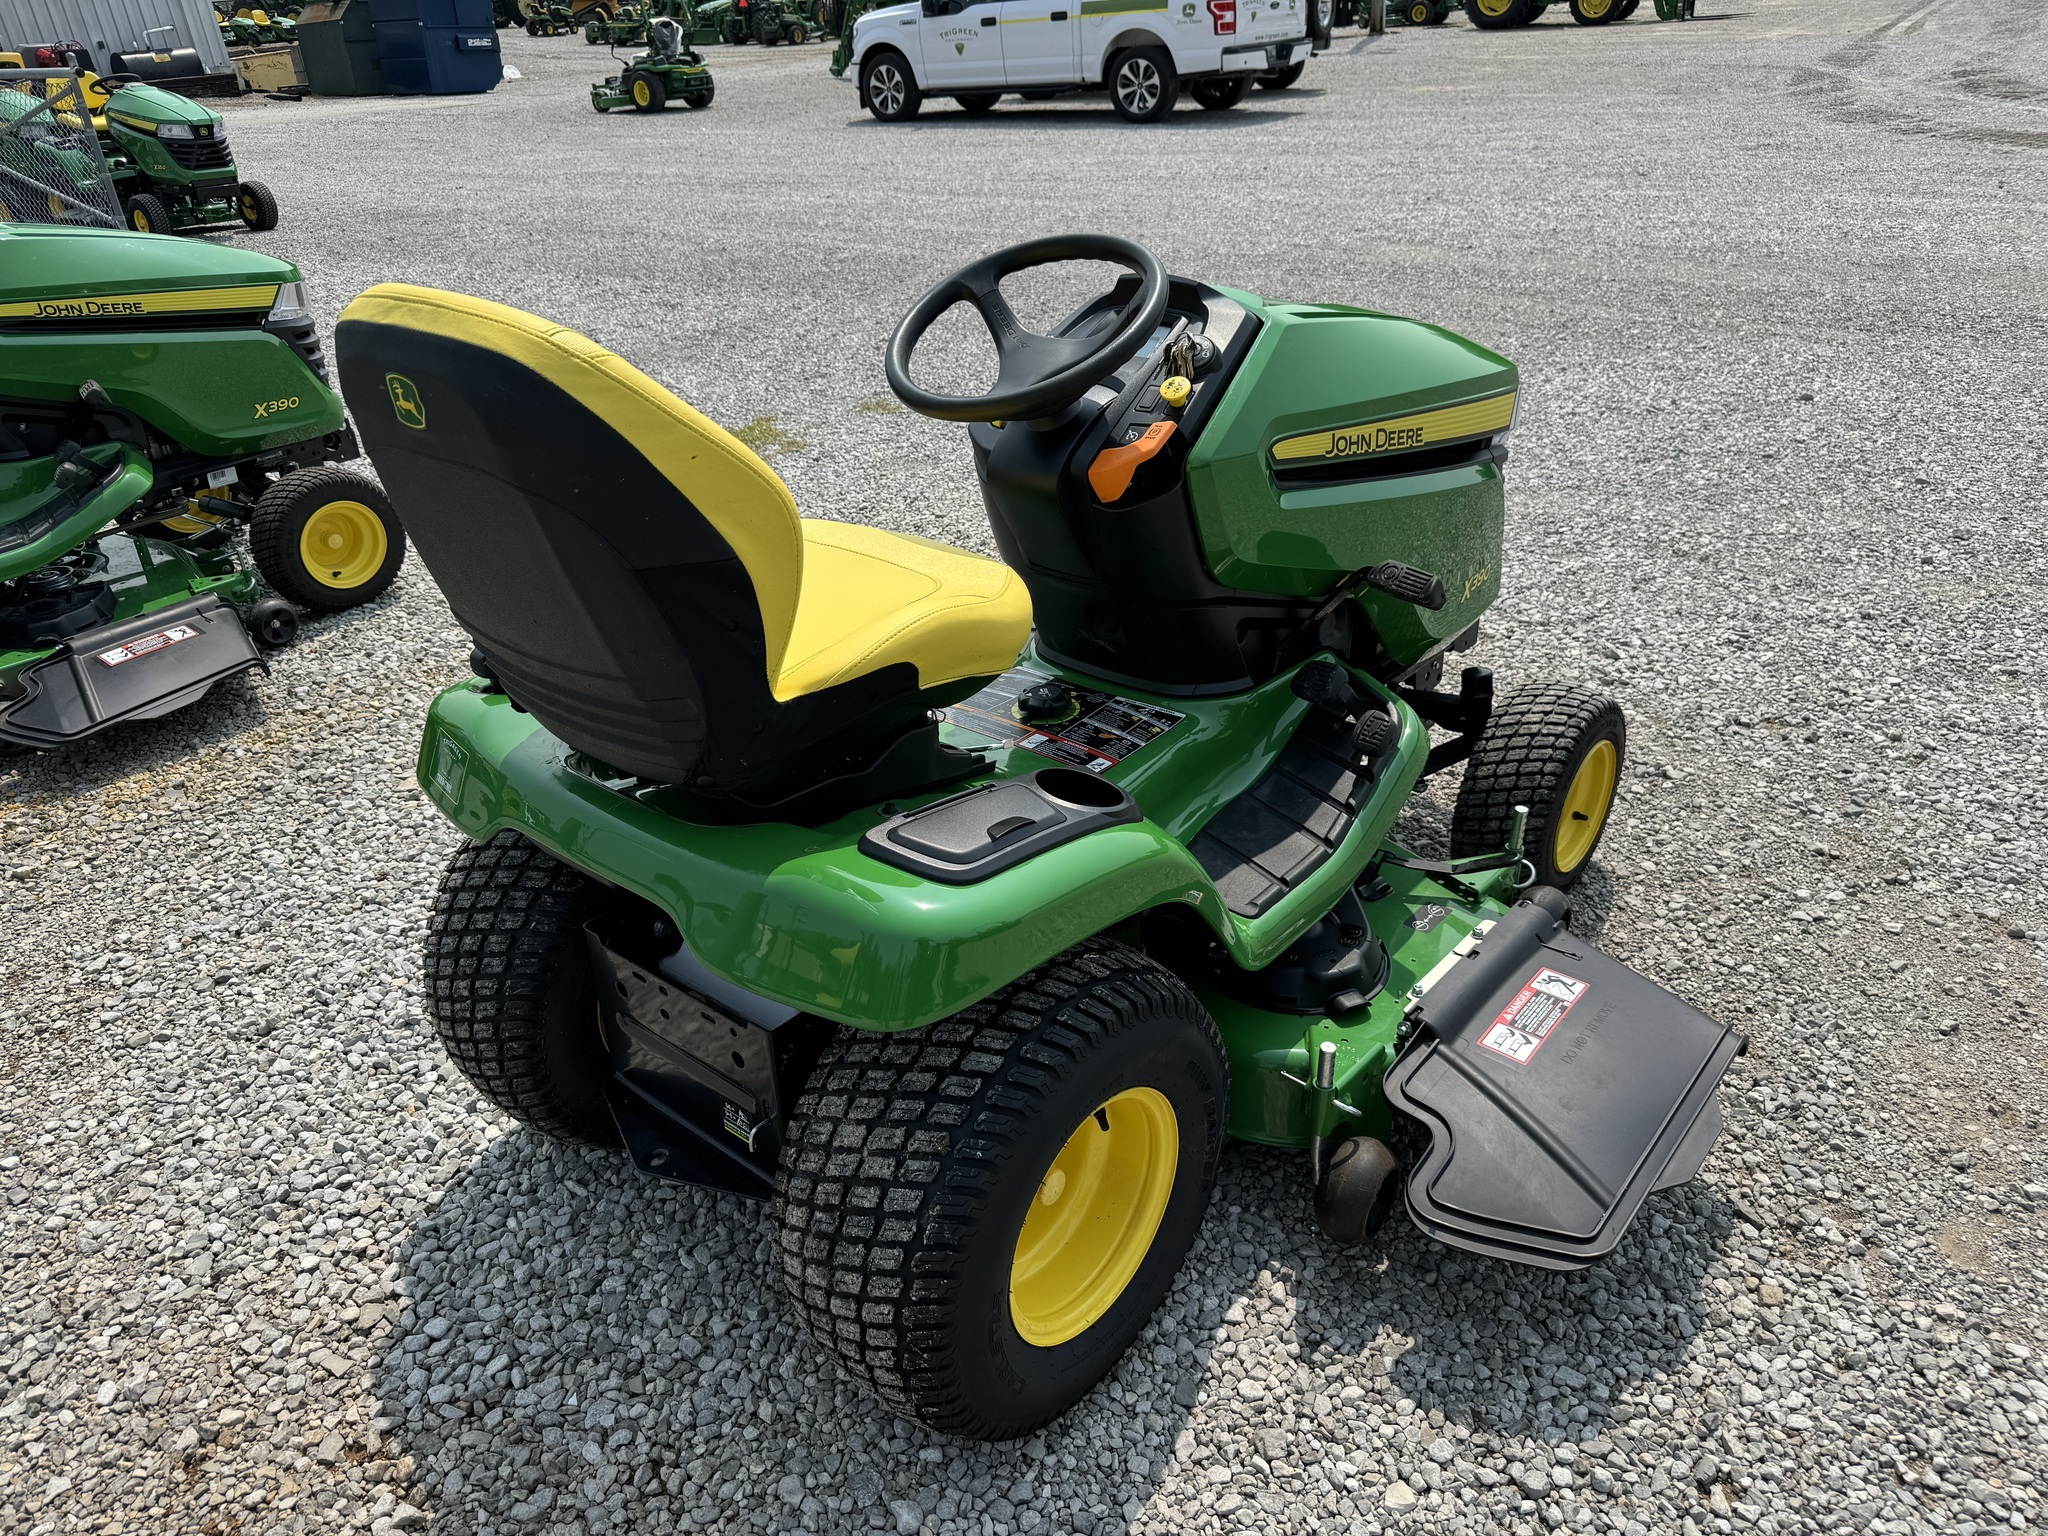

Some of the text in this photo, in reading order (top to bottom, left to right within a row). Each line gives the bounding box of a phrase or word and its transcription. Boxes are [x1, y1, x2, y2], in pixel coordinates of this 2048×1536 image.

[34, 301, 146, 317] JOHN DEERE
[992, 303, 1017, 337] DEERE
[253, 396, 300, 419] X390
[1325, 427, 1424, 457] JOHN DEERE
[1460, 563, 1491, 604] X390
[1508, 990, 1533, 1016] DANGER
[1560, 1049, 1578, 1065] DO
[1571, 1031, 1592, 1051] NOT
